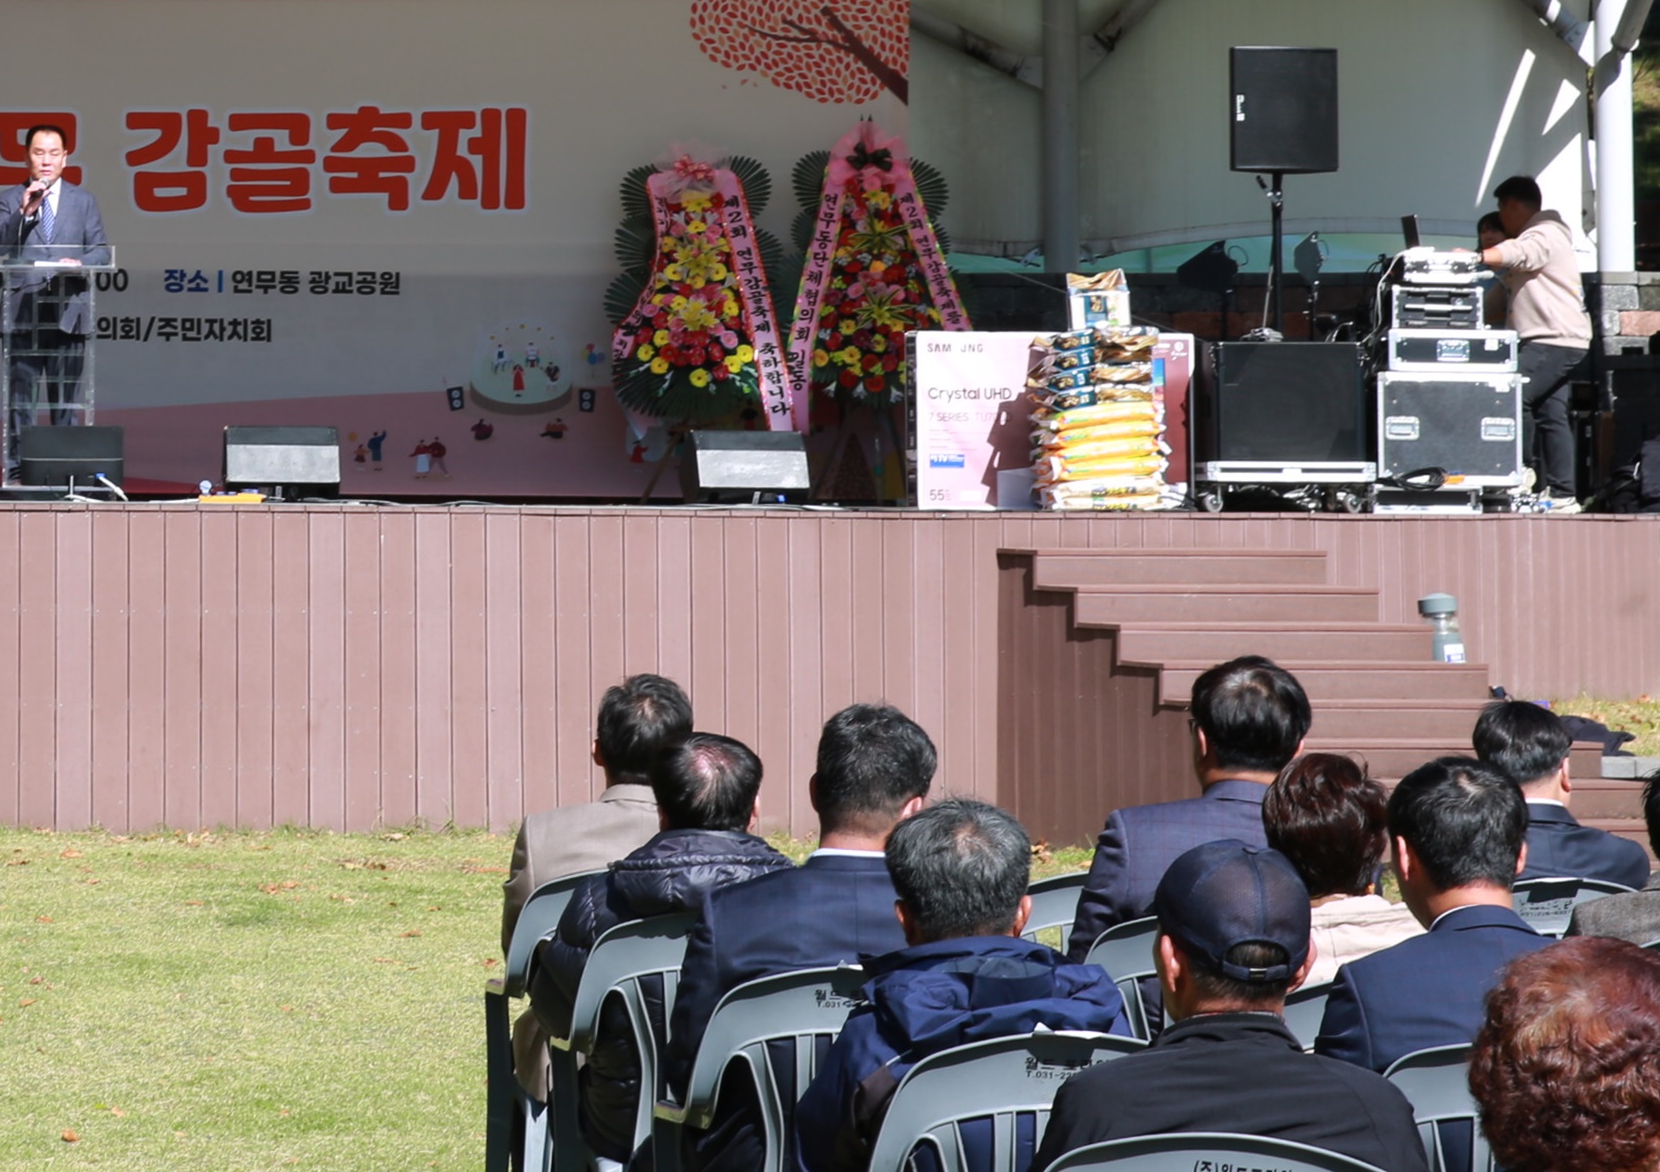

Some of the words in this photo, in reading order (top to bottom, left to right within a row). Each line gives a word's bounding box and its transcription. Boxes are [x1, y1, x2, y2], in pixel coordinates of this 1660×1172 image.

[125, 104, 529, 215] 감골축제
[900, 192, 924, 231] 제2회
[163, 269, 210, 294] 장소
[231, 269, 301, 295] 연무동
[308, 271, 402, 296] 광교공원
[724, 194, 747, 239] 제2회
[736, 246, 772, 334] 연무감골축제
[759, 342, 790, 417] 축하합니다
[928, 387, 981, 404] Crystal
[984, 387, 1012, 400] UHD
[936, 412, 969, 422] SERIES
[929, 489, 946, 501] 55
